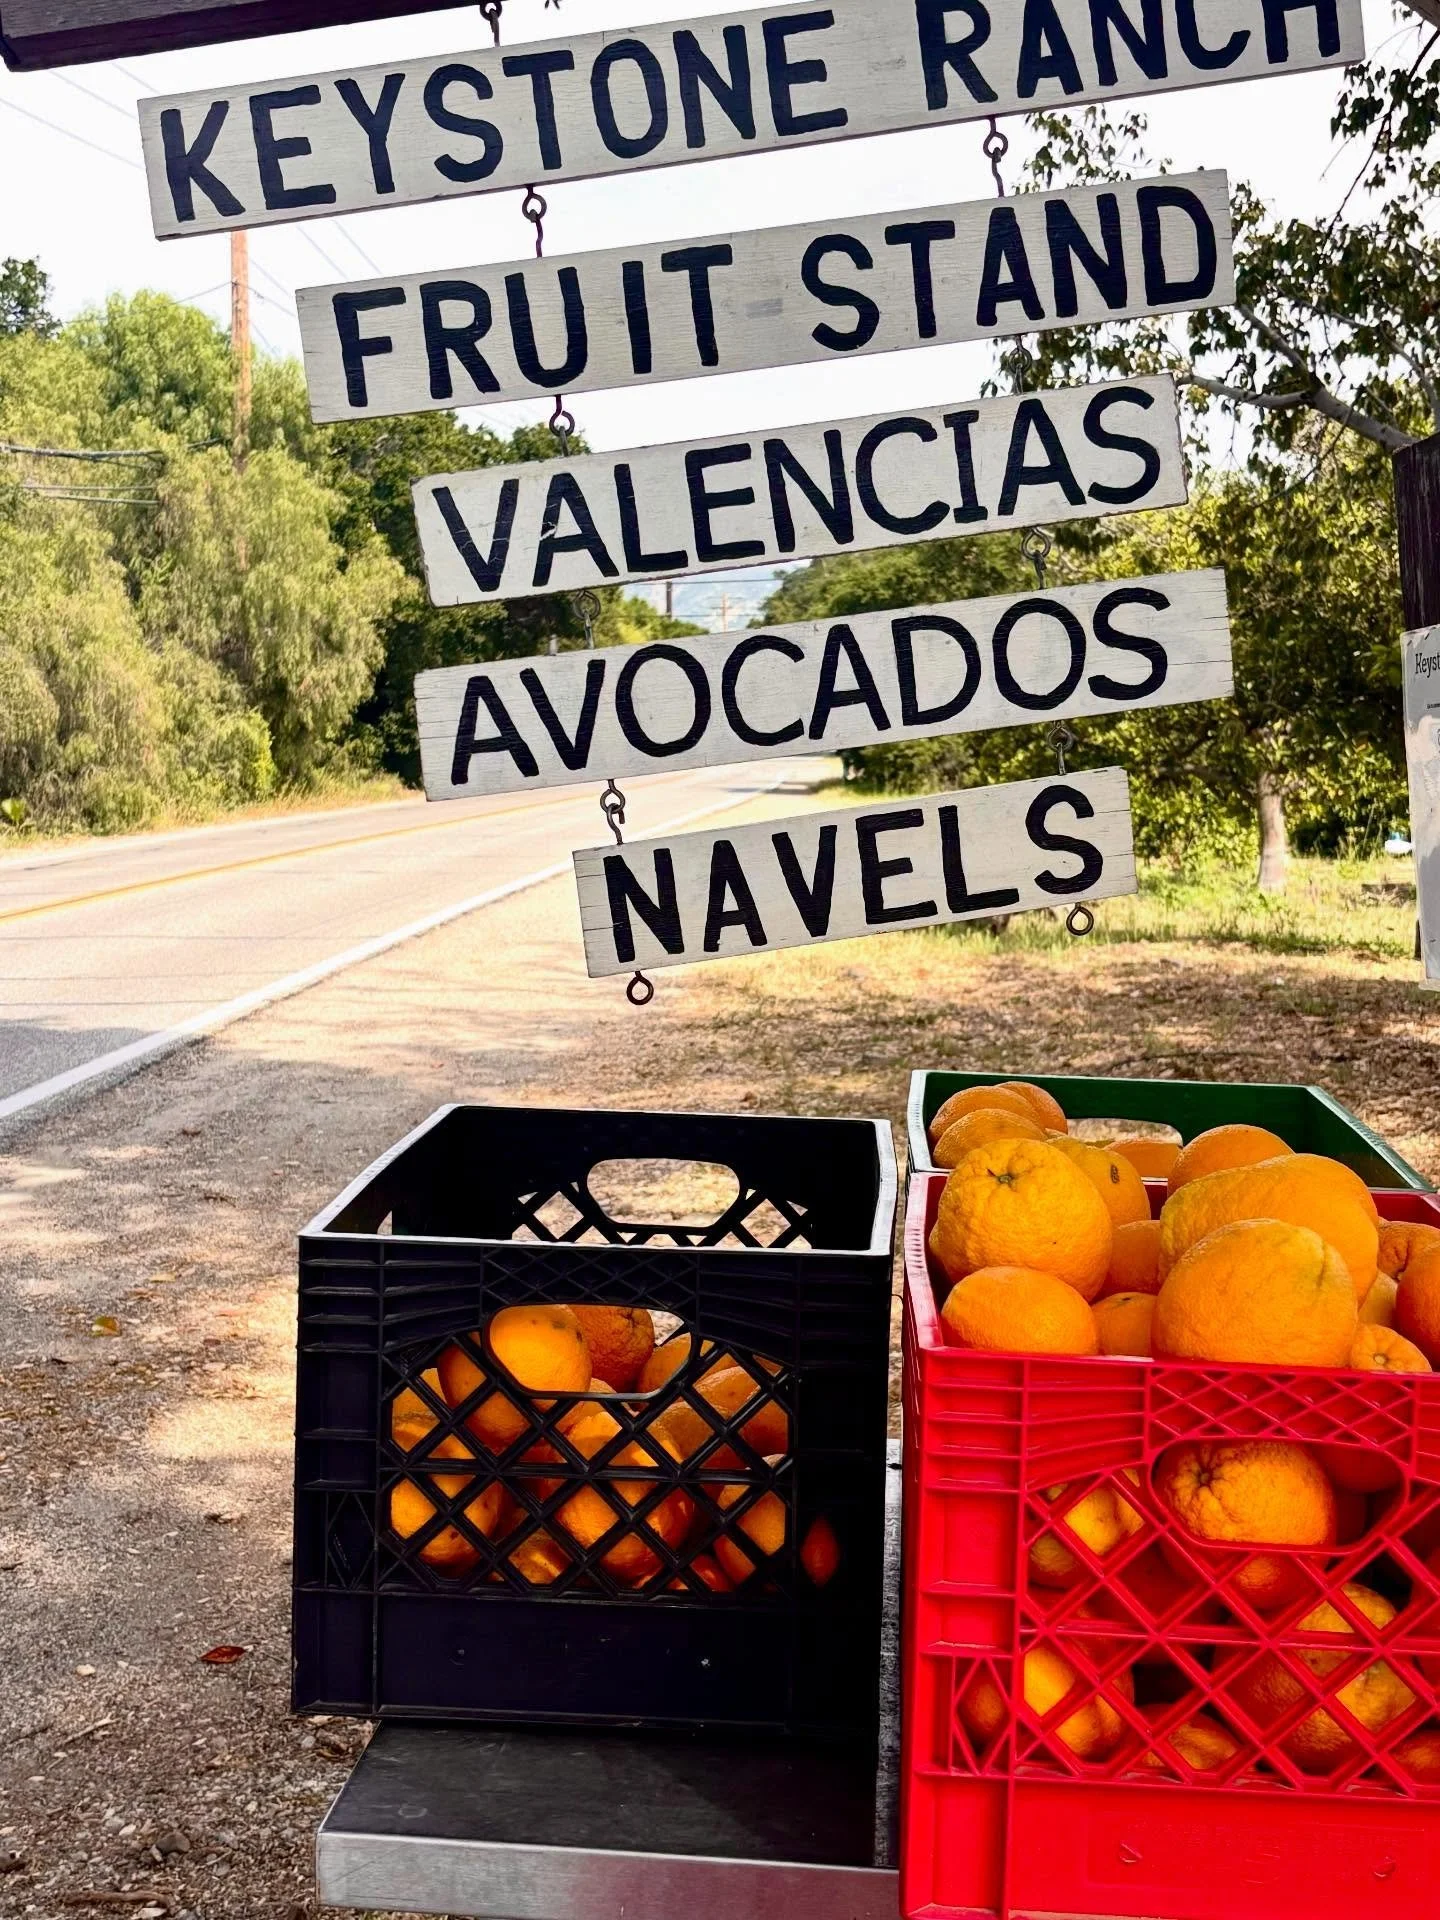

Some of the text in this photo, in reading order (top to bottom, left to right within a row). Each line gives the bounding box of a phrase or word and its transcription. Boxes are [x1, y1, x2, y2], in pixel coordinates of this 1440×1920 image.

[160, 0, 1341, 223] KEYSTONE RANCH
[331, 185, 1218, 408] FRUIT STAND
[431, 386, 1161, 592] VALENCIAS
[450, 587, 1172, 786] AVOCADOS
[602, 785, 1104, 964] NAVELS
